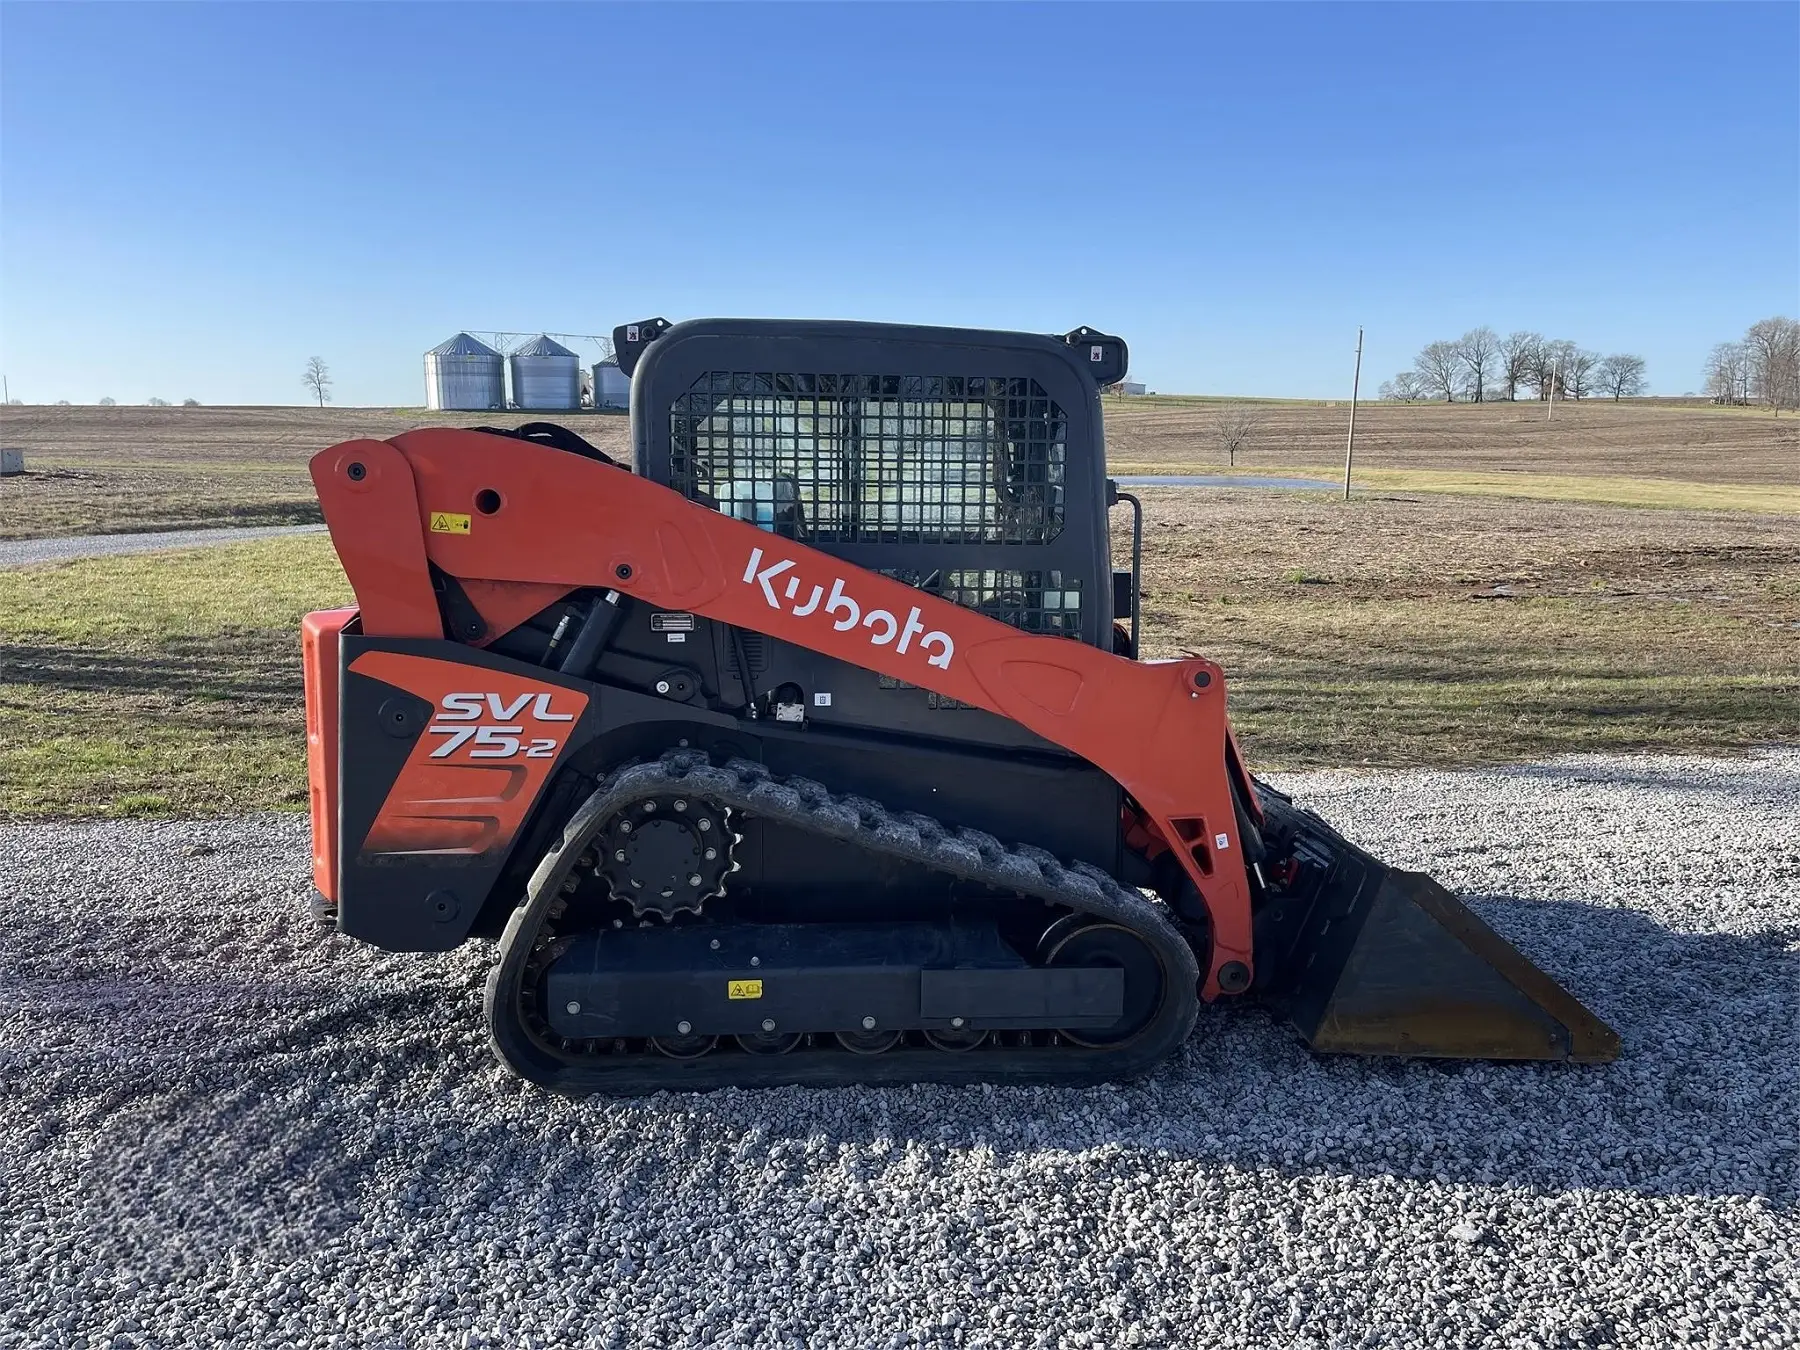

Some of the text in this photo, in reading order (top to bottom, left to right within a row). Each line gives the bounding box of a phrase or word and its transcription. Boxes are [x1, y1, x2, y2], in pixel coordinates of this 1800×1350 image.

[743, 548, 954, 670] Kubota
[435, 693, 574, 721] SVL
[428, 726, 557, 758] 75-2
